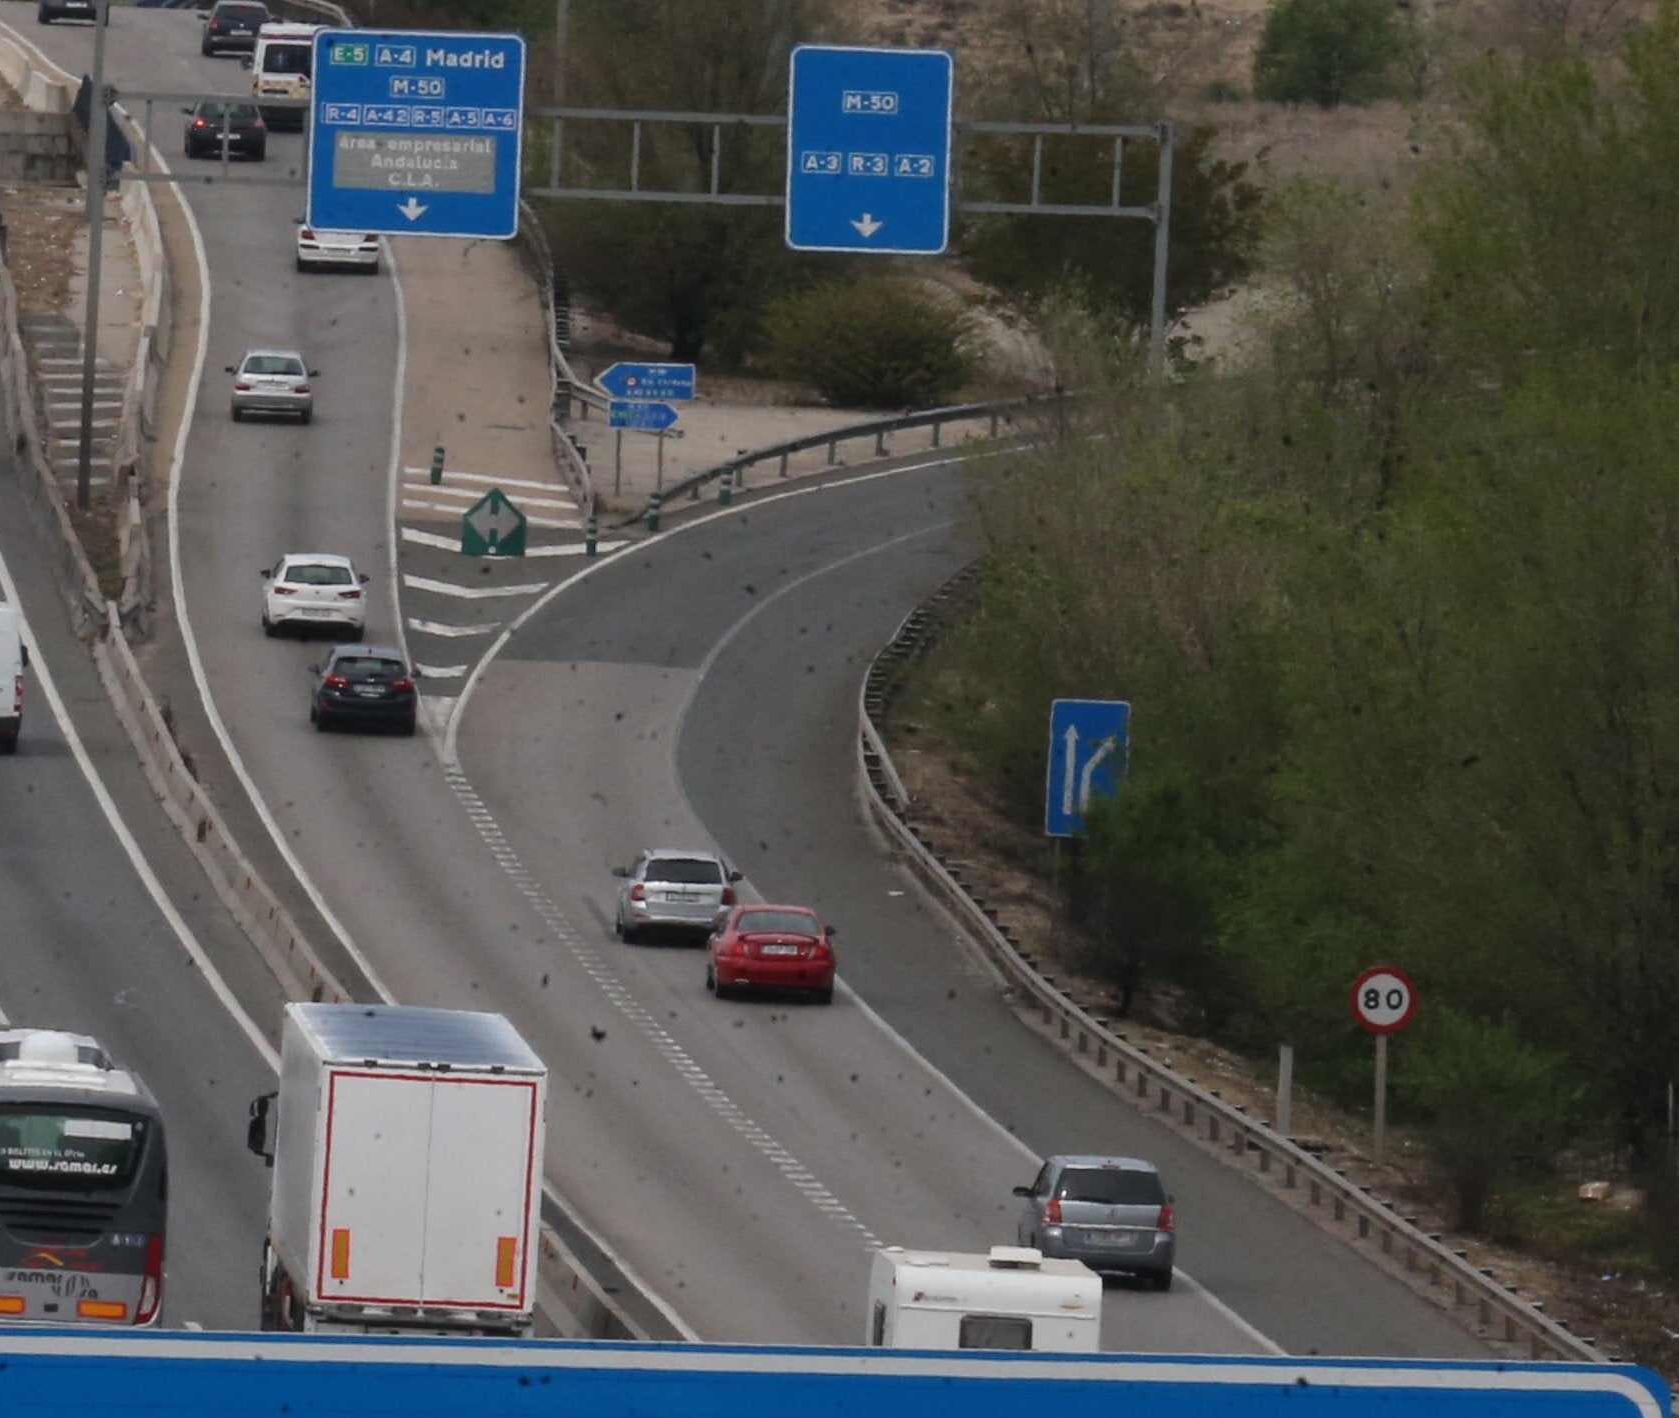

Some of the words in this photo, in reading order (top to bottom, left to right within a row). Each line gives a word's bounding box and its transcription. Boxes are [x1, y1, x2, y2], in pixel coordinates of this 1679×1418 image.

[333, 47, 364, 62] E-5
[379, 48, 413, 63] A-4
[425, 49, 505, 69] Madrid
[392, 79, 442, 95] M-50
[845, 94, 895, 110] M-50
[327, 107, 359, 120] R-4
[365, 108, 408, 123] A-42
[412, 110, 442, 124] R-5
[449, 111, 478, 125] A-5
[484, 112, 514, 127] A-6
[338, 136, 376, 150] área
[387, 139, 491, 154] empresarial
[805, 155, 838, 170] A-3
[852, 156, 884, 172] R-3
[898, 158, 931, 174] A-2
[1364, 988, 1403, 1010] 80
